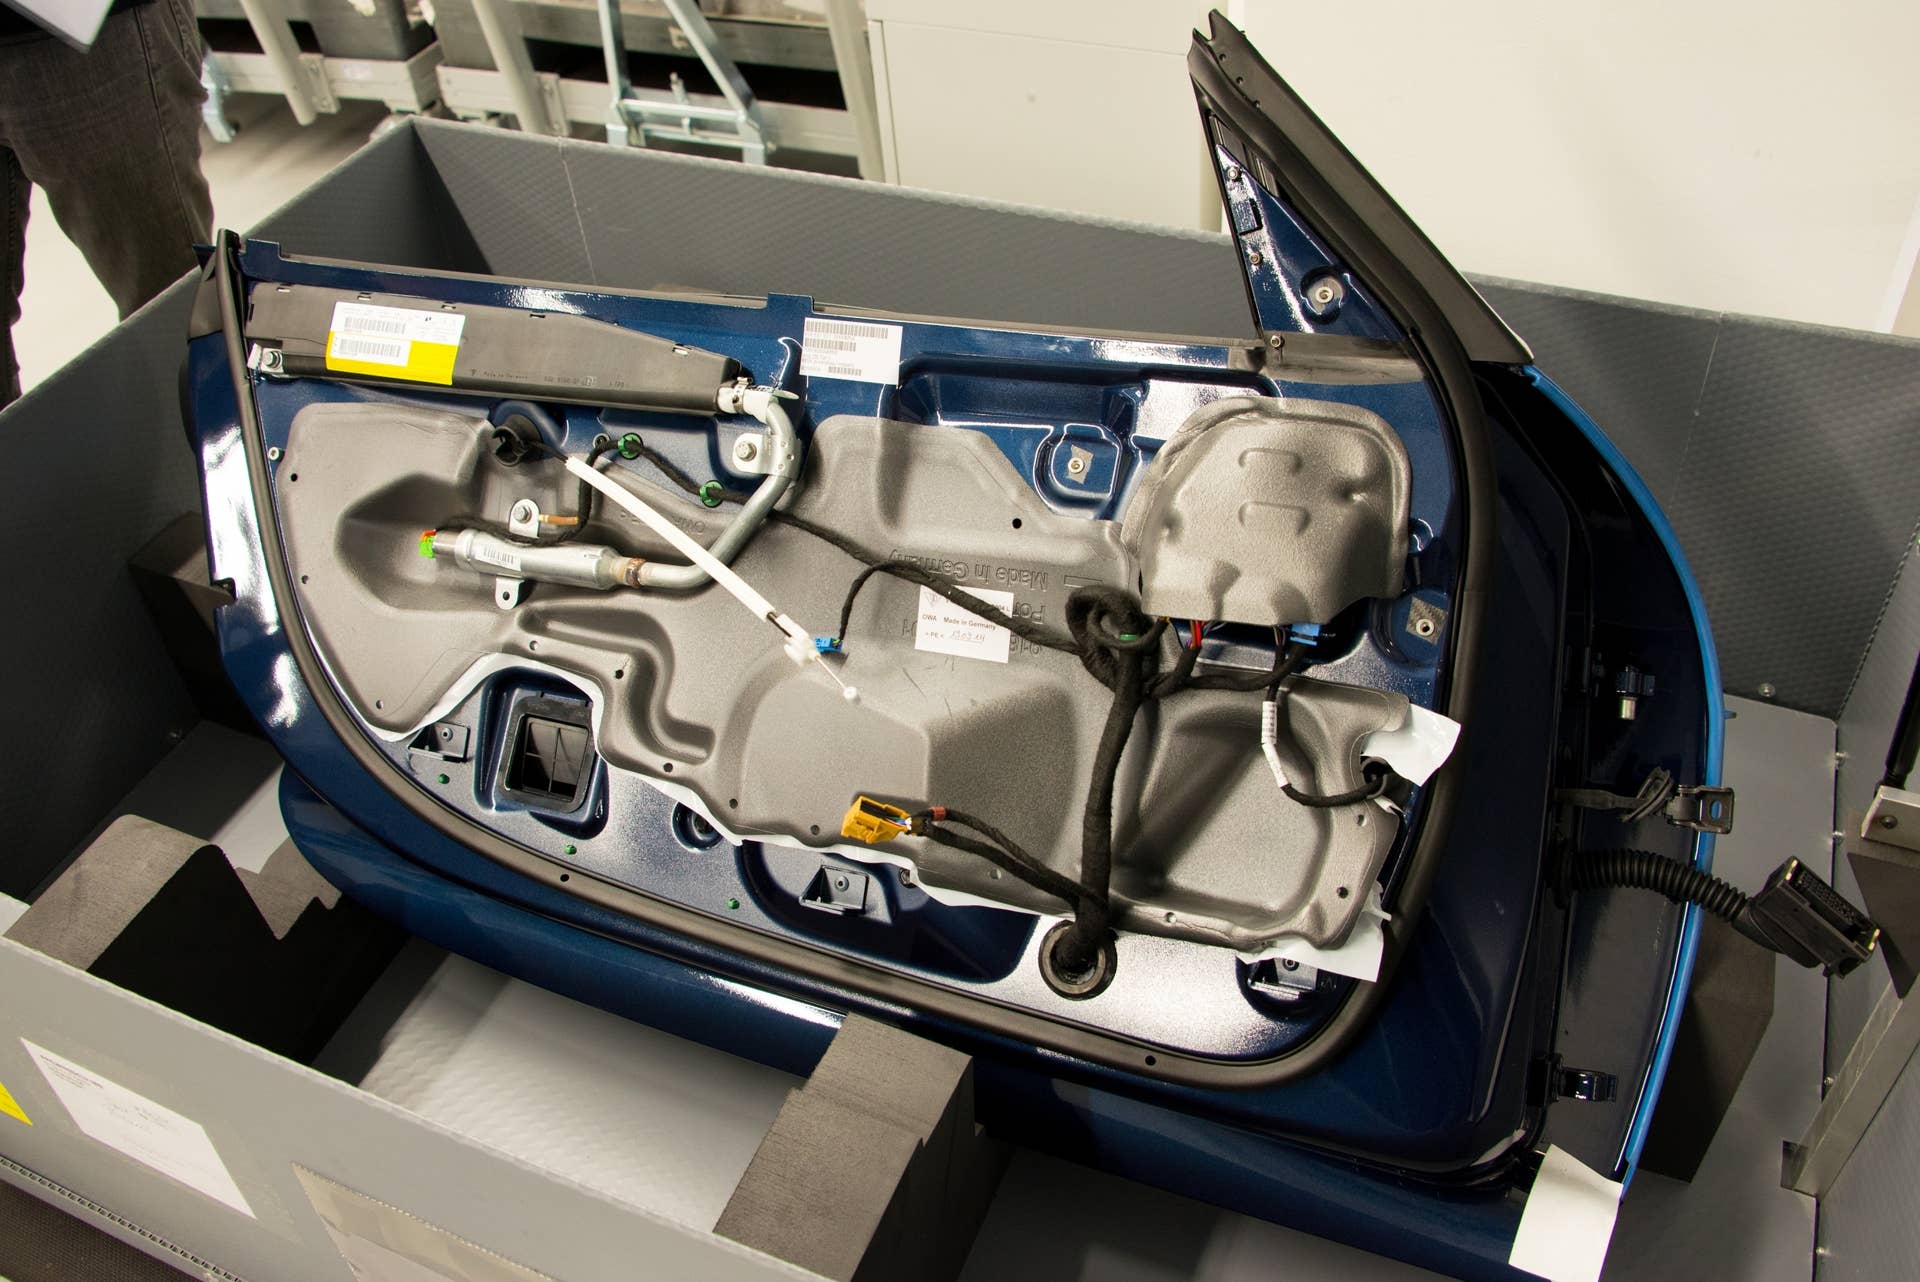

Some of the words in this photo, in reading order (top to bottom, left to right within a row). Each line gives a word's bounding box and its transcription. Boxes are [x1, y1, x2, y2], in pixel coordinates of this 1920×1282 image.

[974, 563, 991, 585] in
[996, 567, 1049, 593] Made
[943, 616, 960, 625] Made
[968, 620, 996, 631] Germany
